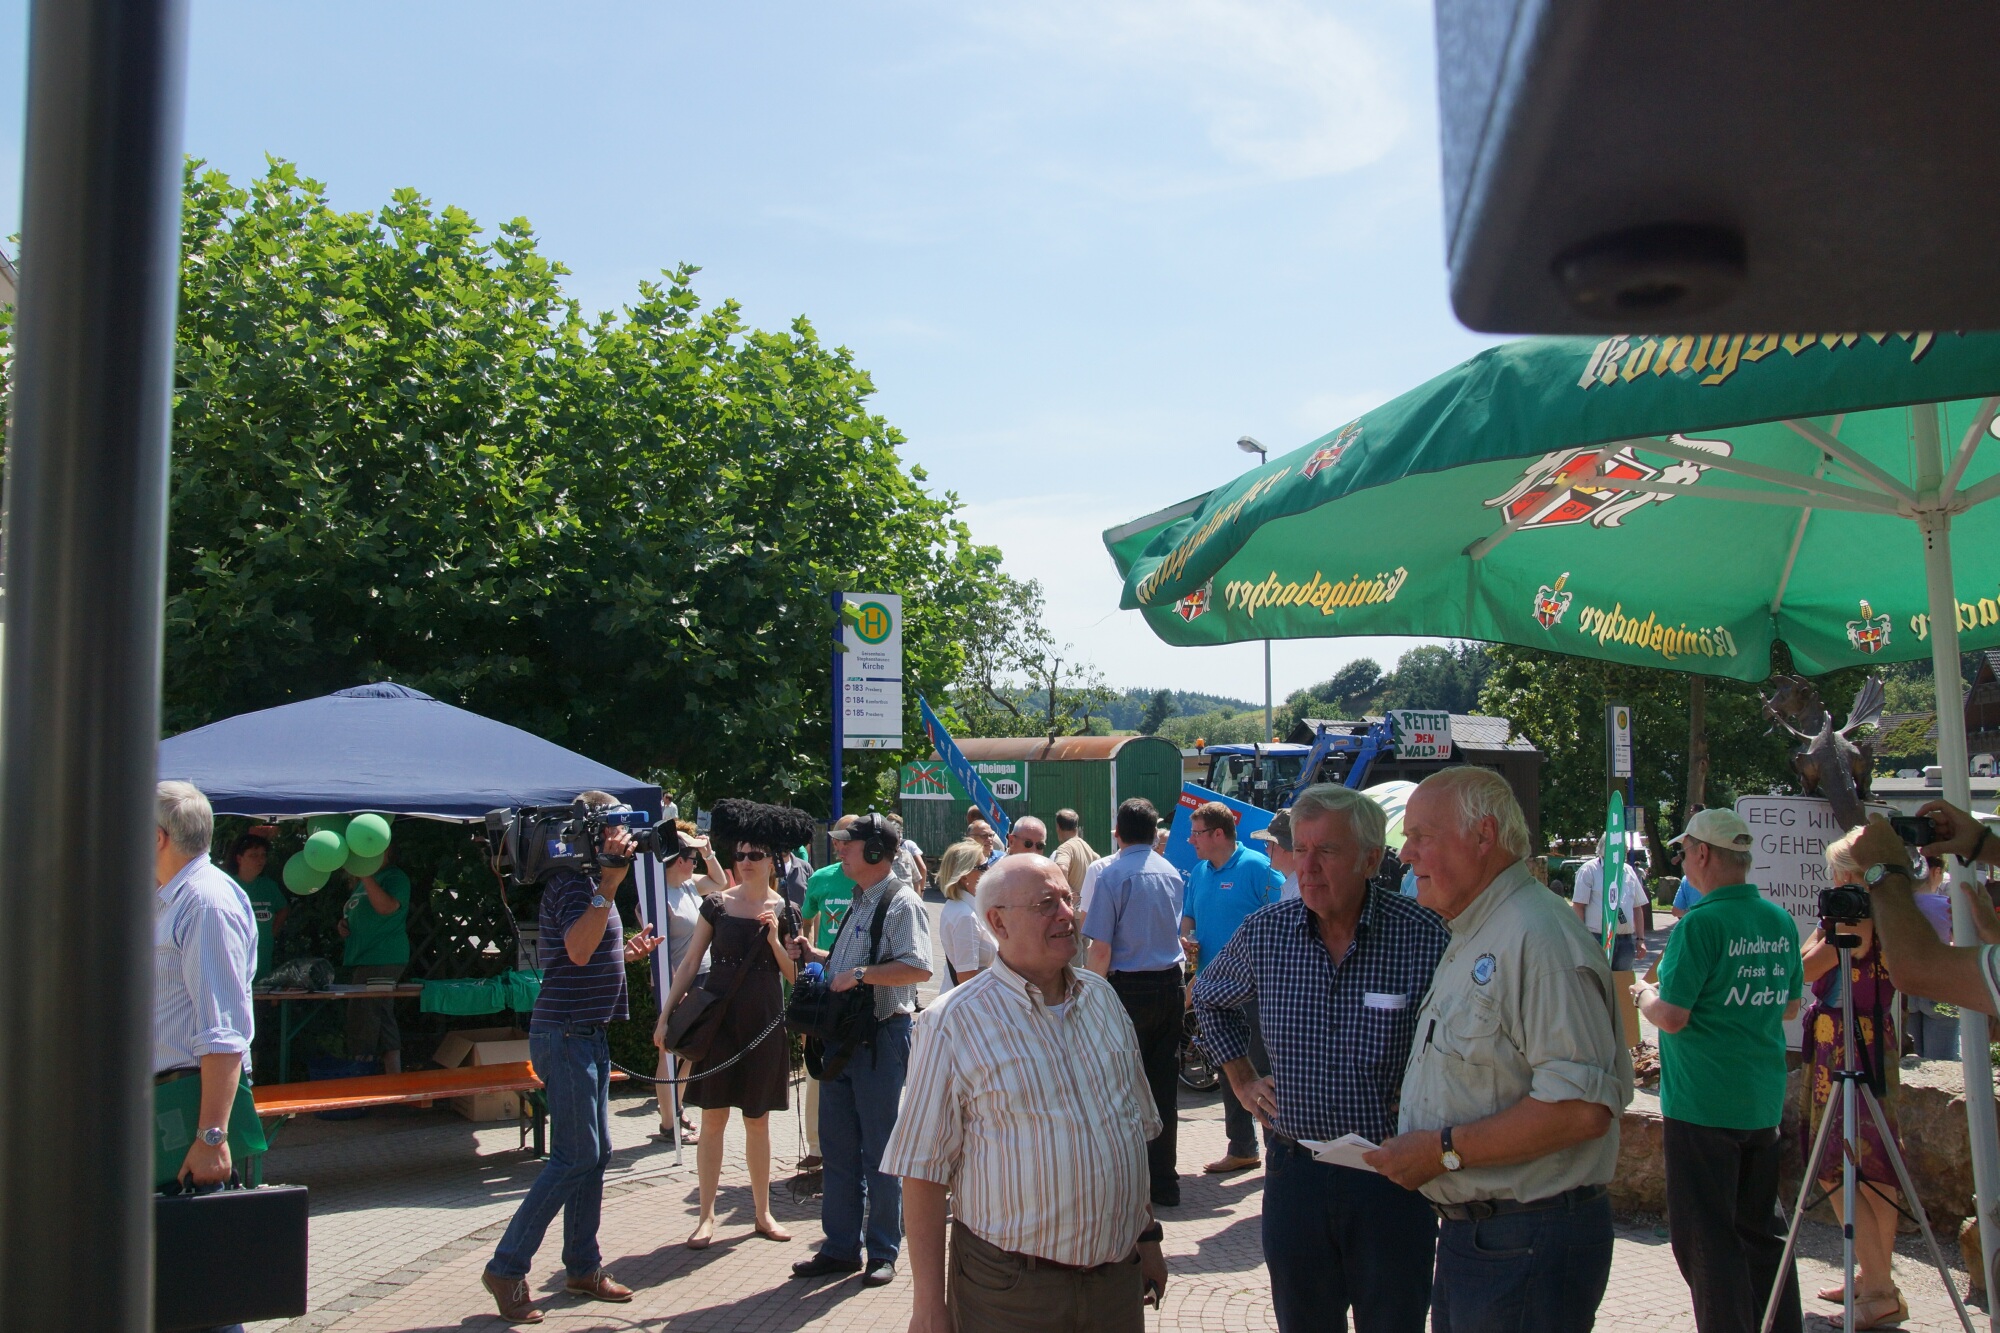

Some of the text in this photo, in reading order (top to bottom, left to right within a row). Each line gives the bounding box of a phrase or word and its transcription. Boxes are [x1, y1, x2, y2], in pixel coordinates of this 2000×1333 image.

[865, 611, 881, 635] H
[862, 662, 885, 670] Kirche
[852, 696, 865, 704] 184
[852, 709, 865, 717] 185
[1401, 712, 1450, 731] RETTET
[1414, 733, 1434, 744] DEN
[1748, 807, 1843, 829] EEG WIN
[1800, 862, 1834, 882] PRO
[1769, 882, 1820, 899] WINDR
[1728, 935, 1790, 957] Windkraft
[1737, 963, 1785, 979] frisst die
